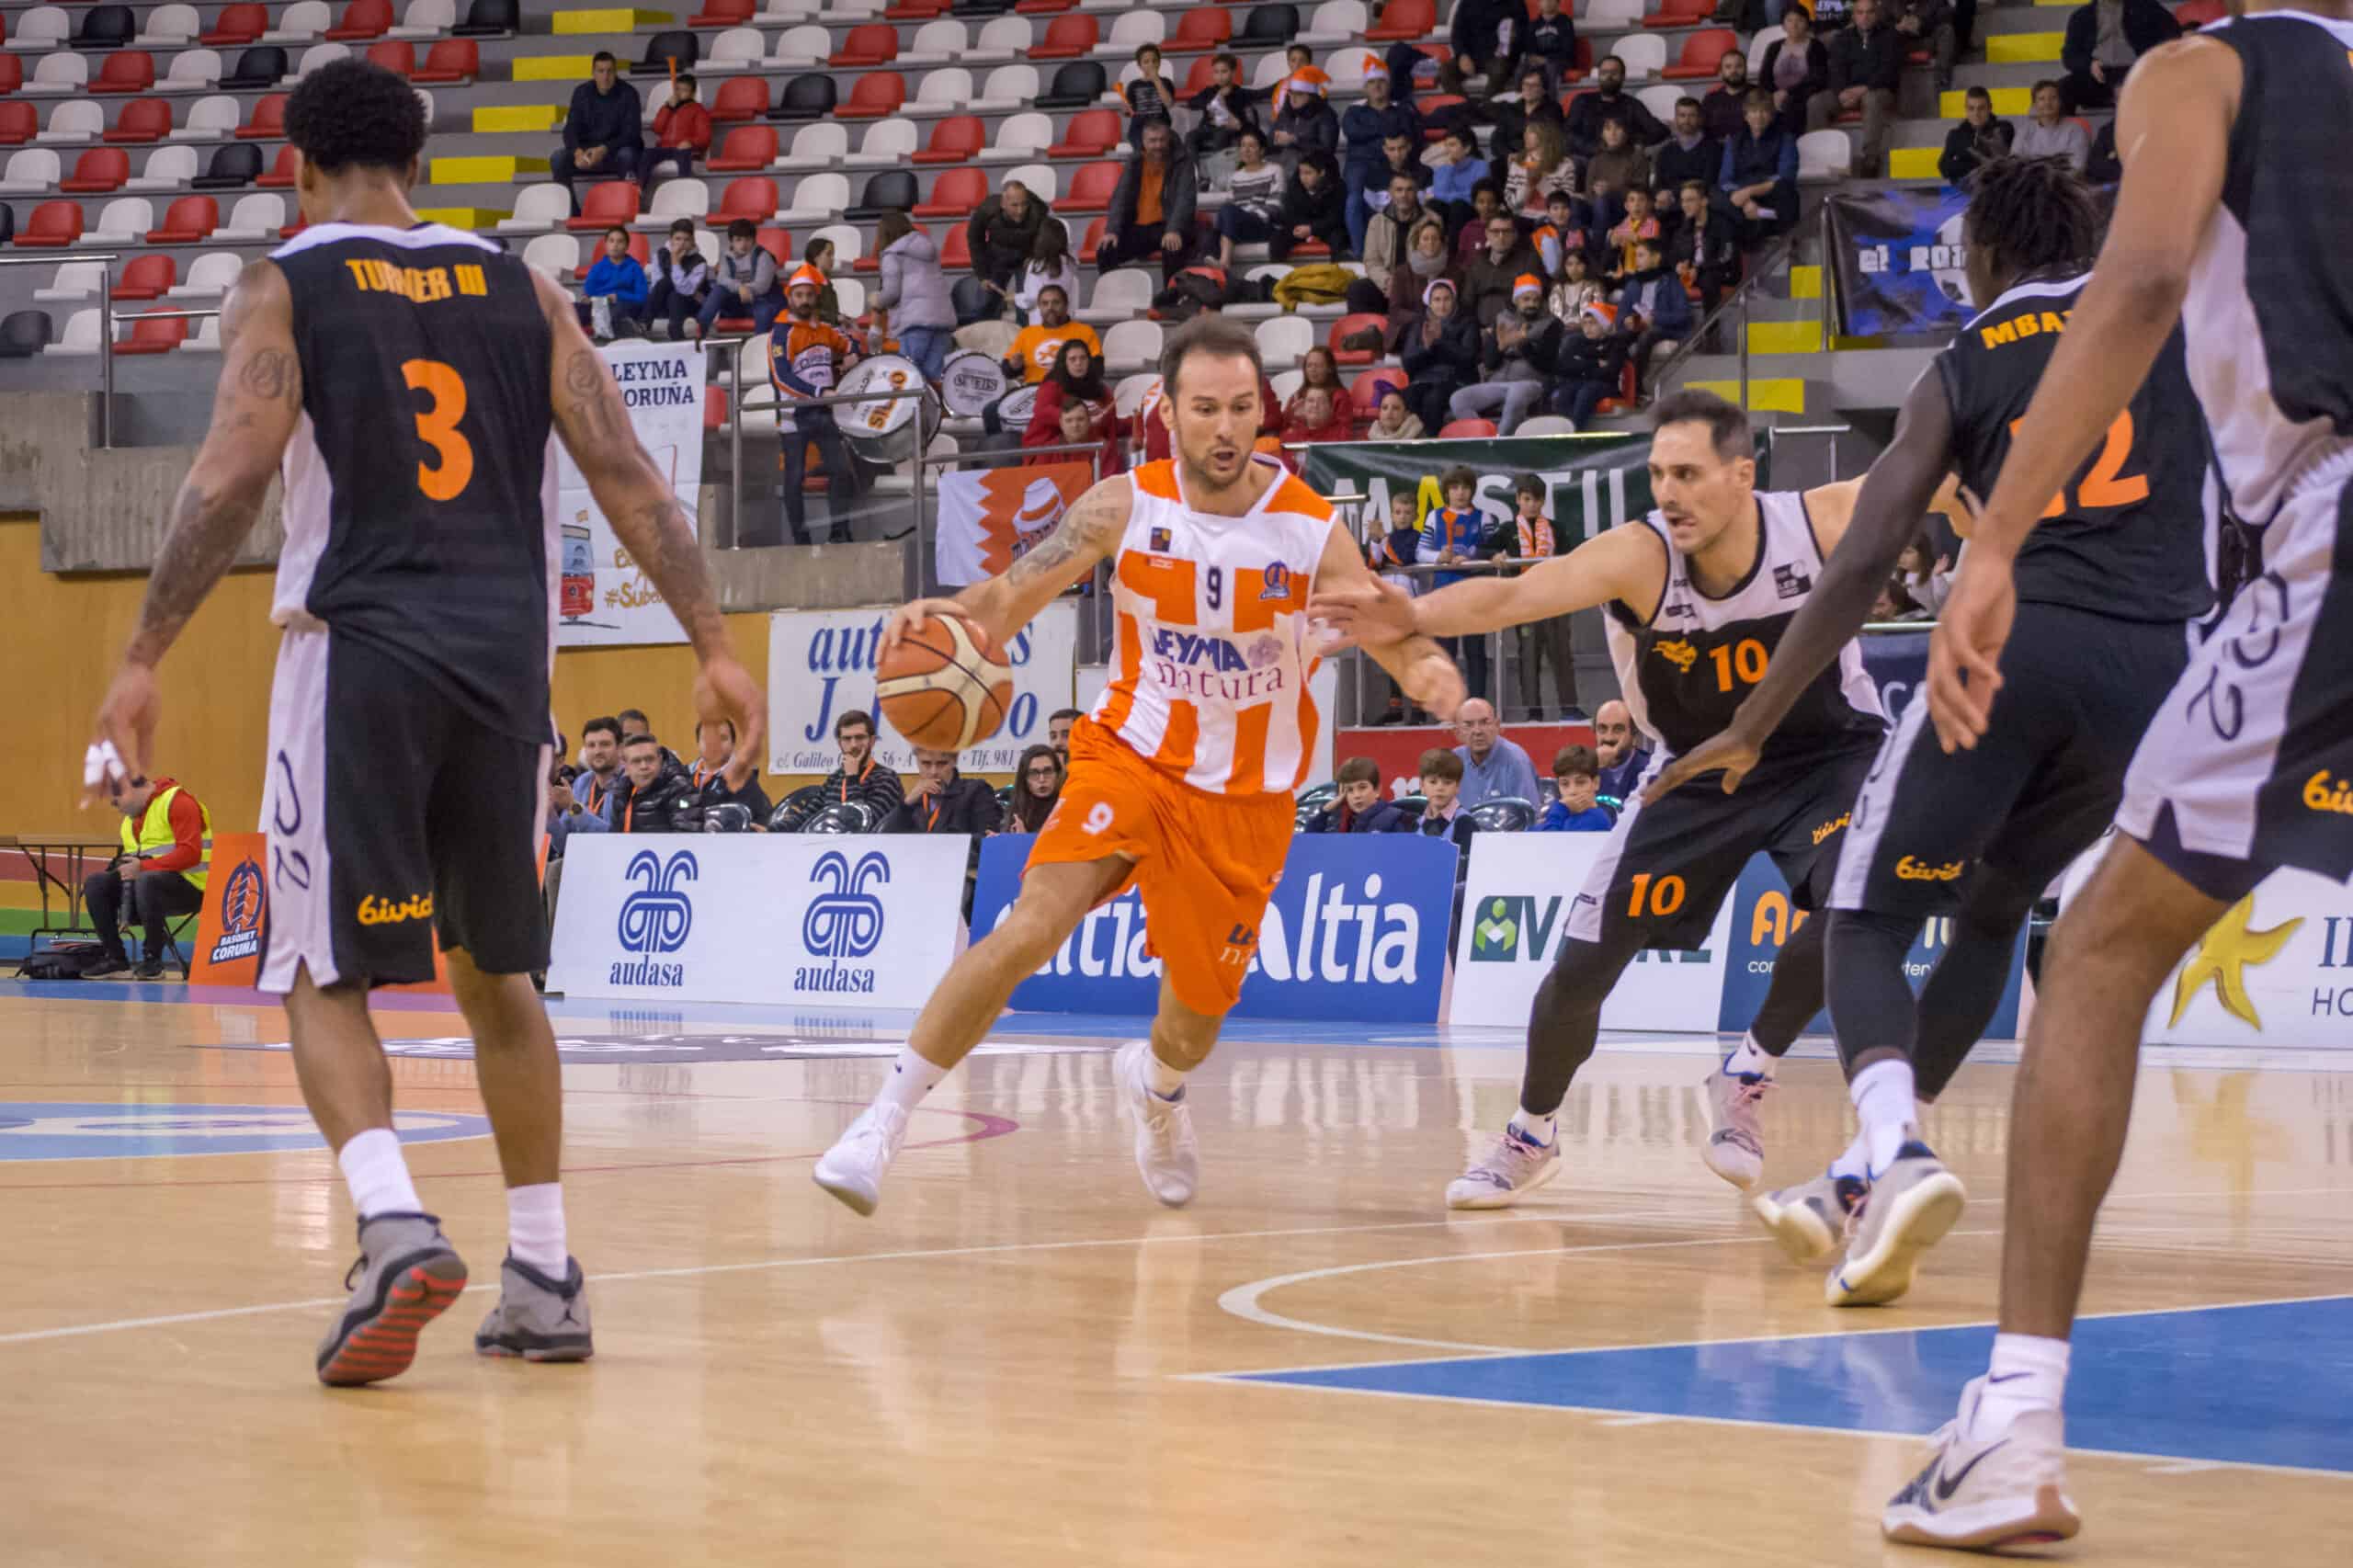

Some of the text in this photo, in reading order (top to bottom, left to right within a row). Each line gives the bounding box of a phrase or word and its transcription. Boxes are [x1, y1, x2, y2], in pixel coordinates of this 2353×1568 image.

[345, 258, 453, 303] TURNER
[1980, 310, 2074, 350] MBA
[611, 359, 688, 381] LEYMA
[619, 381, 696, 407] ORUÑA
[401, 358, 474, 501] 3
[2008, 407, 2151, 518] 2
[1206, 565, 1222, 611] 9
[1154, 628, 1249, 673] LEYMA
[1709, 638, 1769, 692] 10
[1156, 662, 1284, 700] natura
[1081, 801, 1114, 835] 9
[1627, 873, 1686, 917] 10
[609, 955, 684, 987] audasa
[794, 960, 874, 994] audasa
